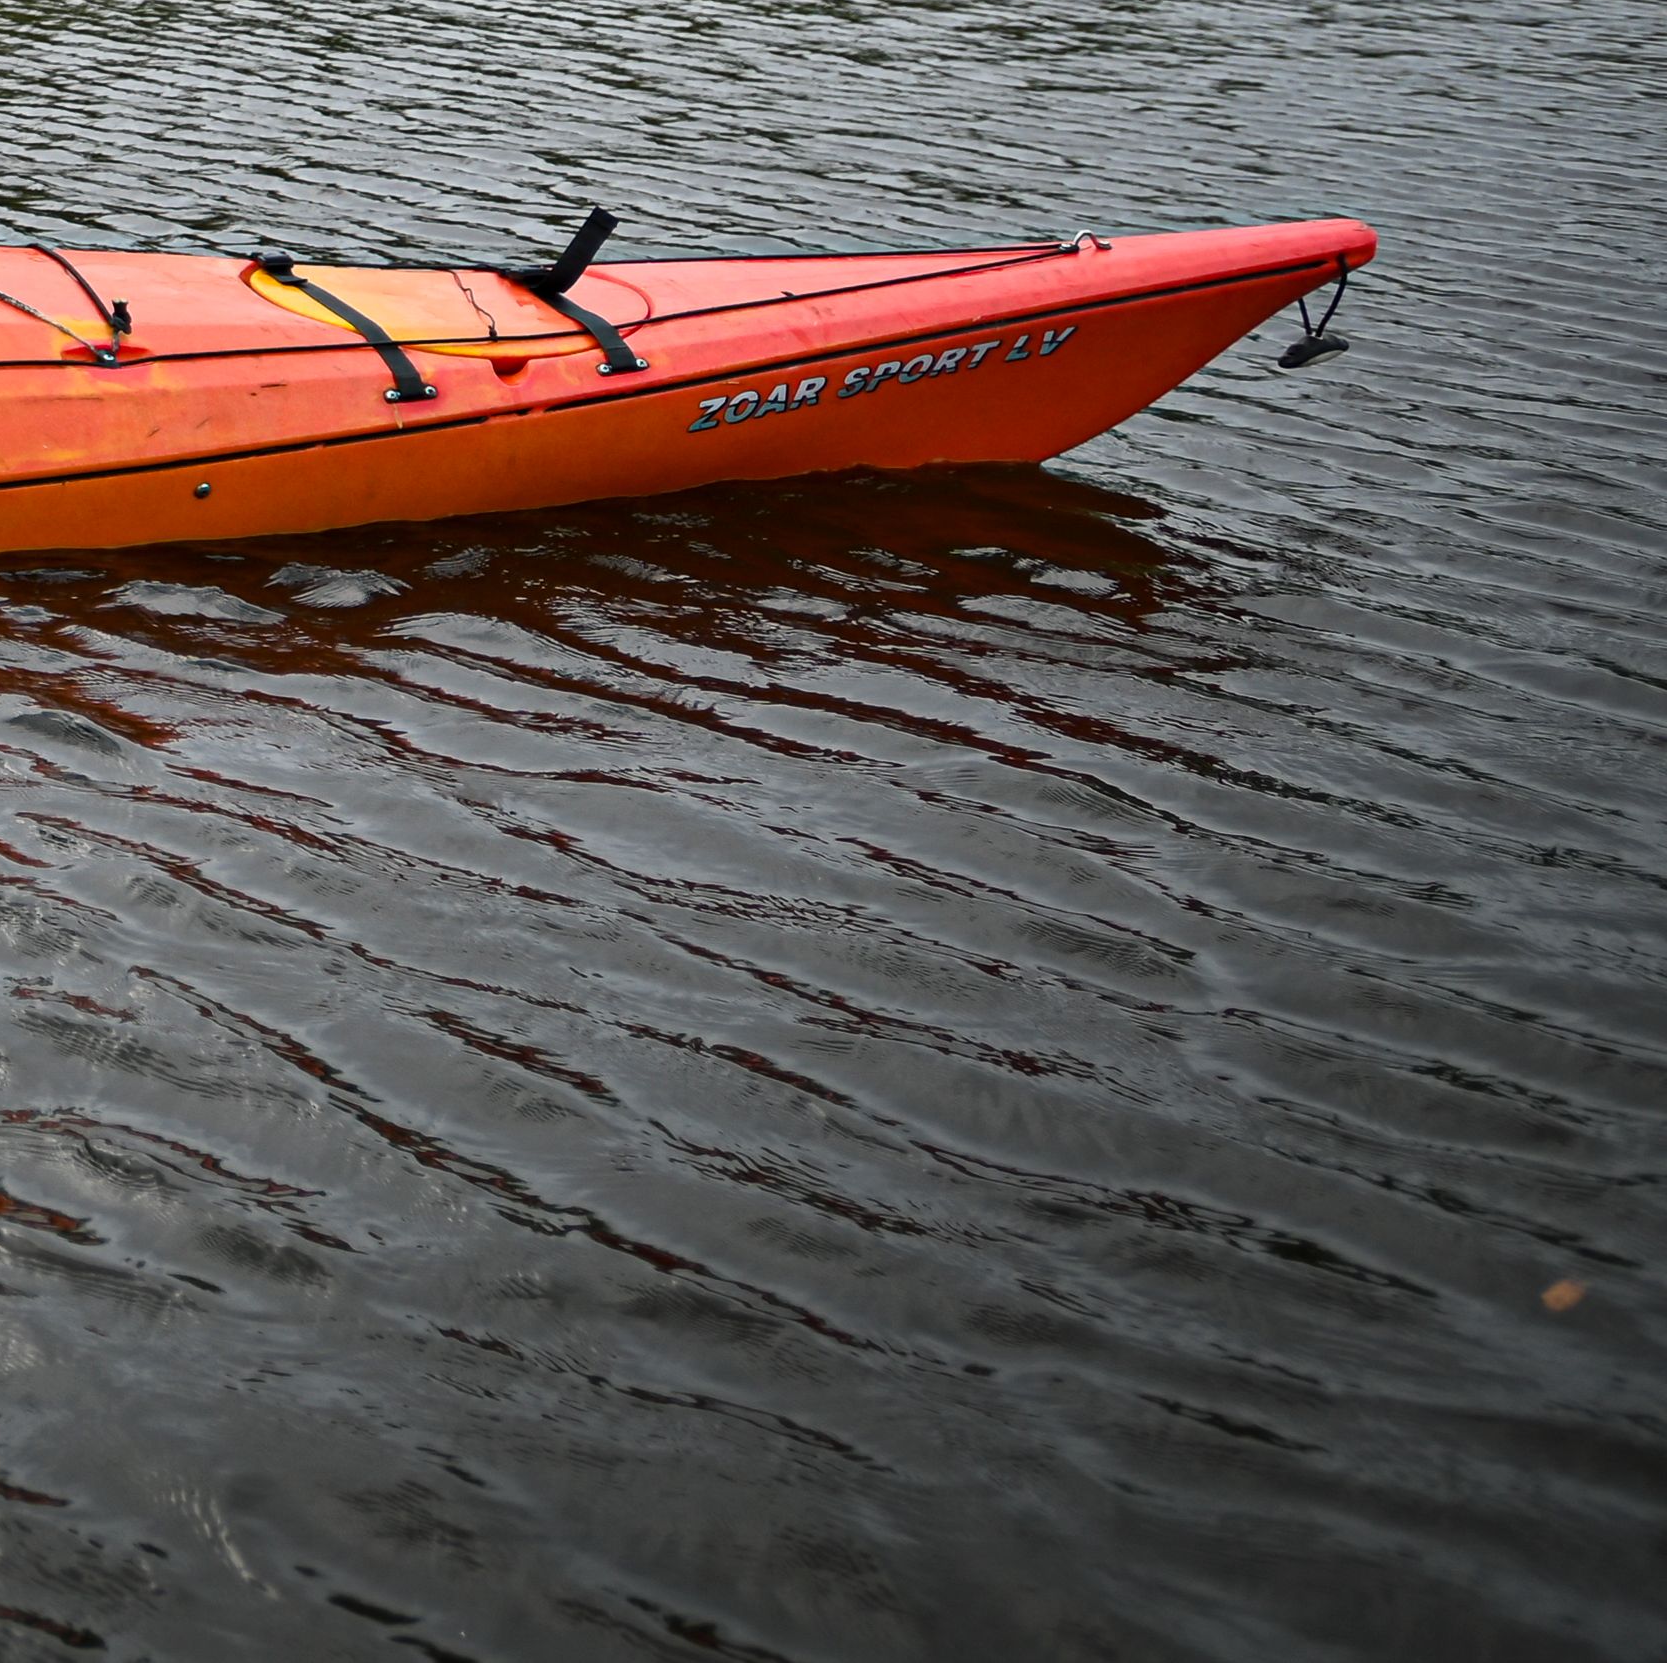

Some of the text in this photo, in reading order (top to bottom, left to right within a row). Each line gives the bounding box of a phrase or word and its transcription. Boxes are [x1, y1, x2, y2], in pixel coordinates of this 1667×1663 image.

[687, 325, 1078, 432] ZOAR SPORT LV
